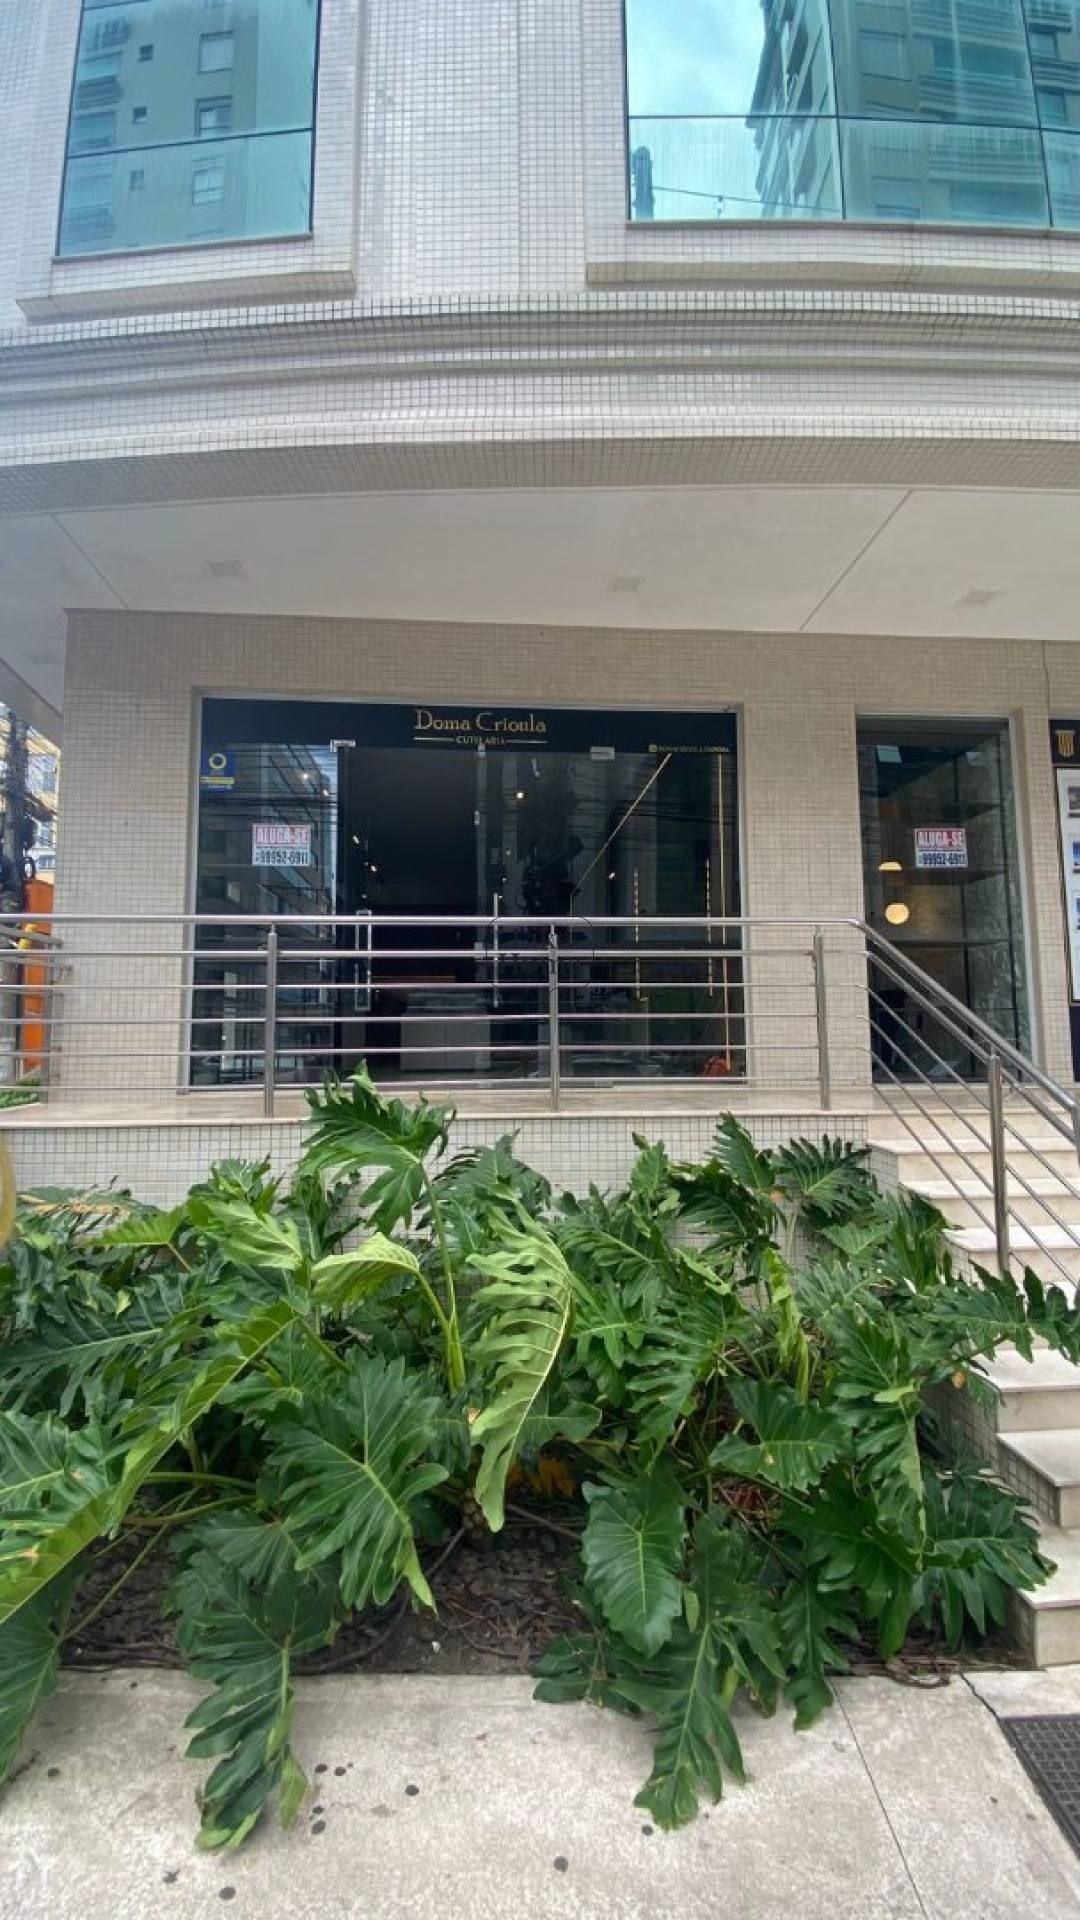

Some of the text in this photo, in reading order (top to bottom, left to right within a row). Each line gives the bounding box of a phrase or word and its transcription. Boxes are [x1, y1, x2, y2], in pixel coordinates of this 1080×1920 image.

[414, 708, 546, 733] Doma Crioula
[256, 827, 309, 844] ALUGA-SE
[918, 831, 964, 847] ALUGA-SE
